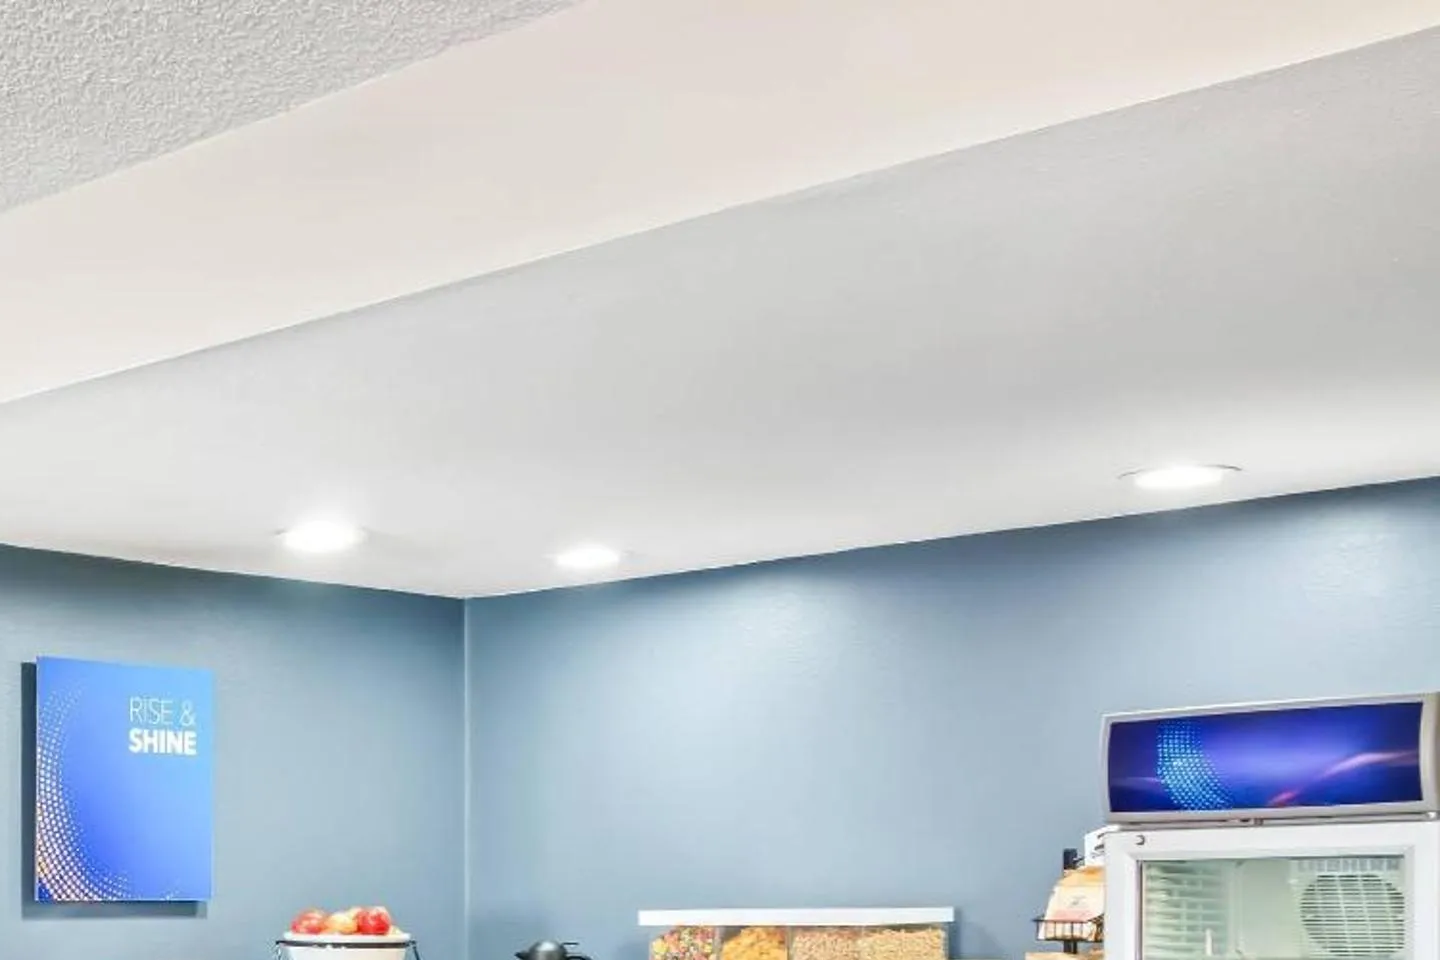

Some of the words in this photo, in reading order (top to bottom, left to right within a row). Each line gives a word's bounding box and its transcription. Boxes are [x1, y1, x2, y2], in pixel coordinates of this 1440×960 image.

[129, 696, 174, 725] RISE
[179, 700, 196, 727] &
[128, 728, 197, 755] SHINE
